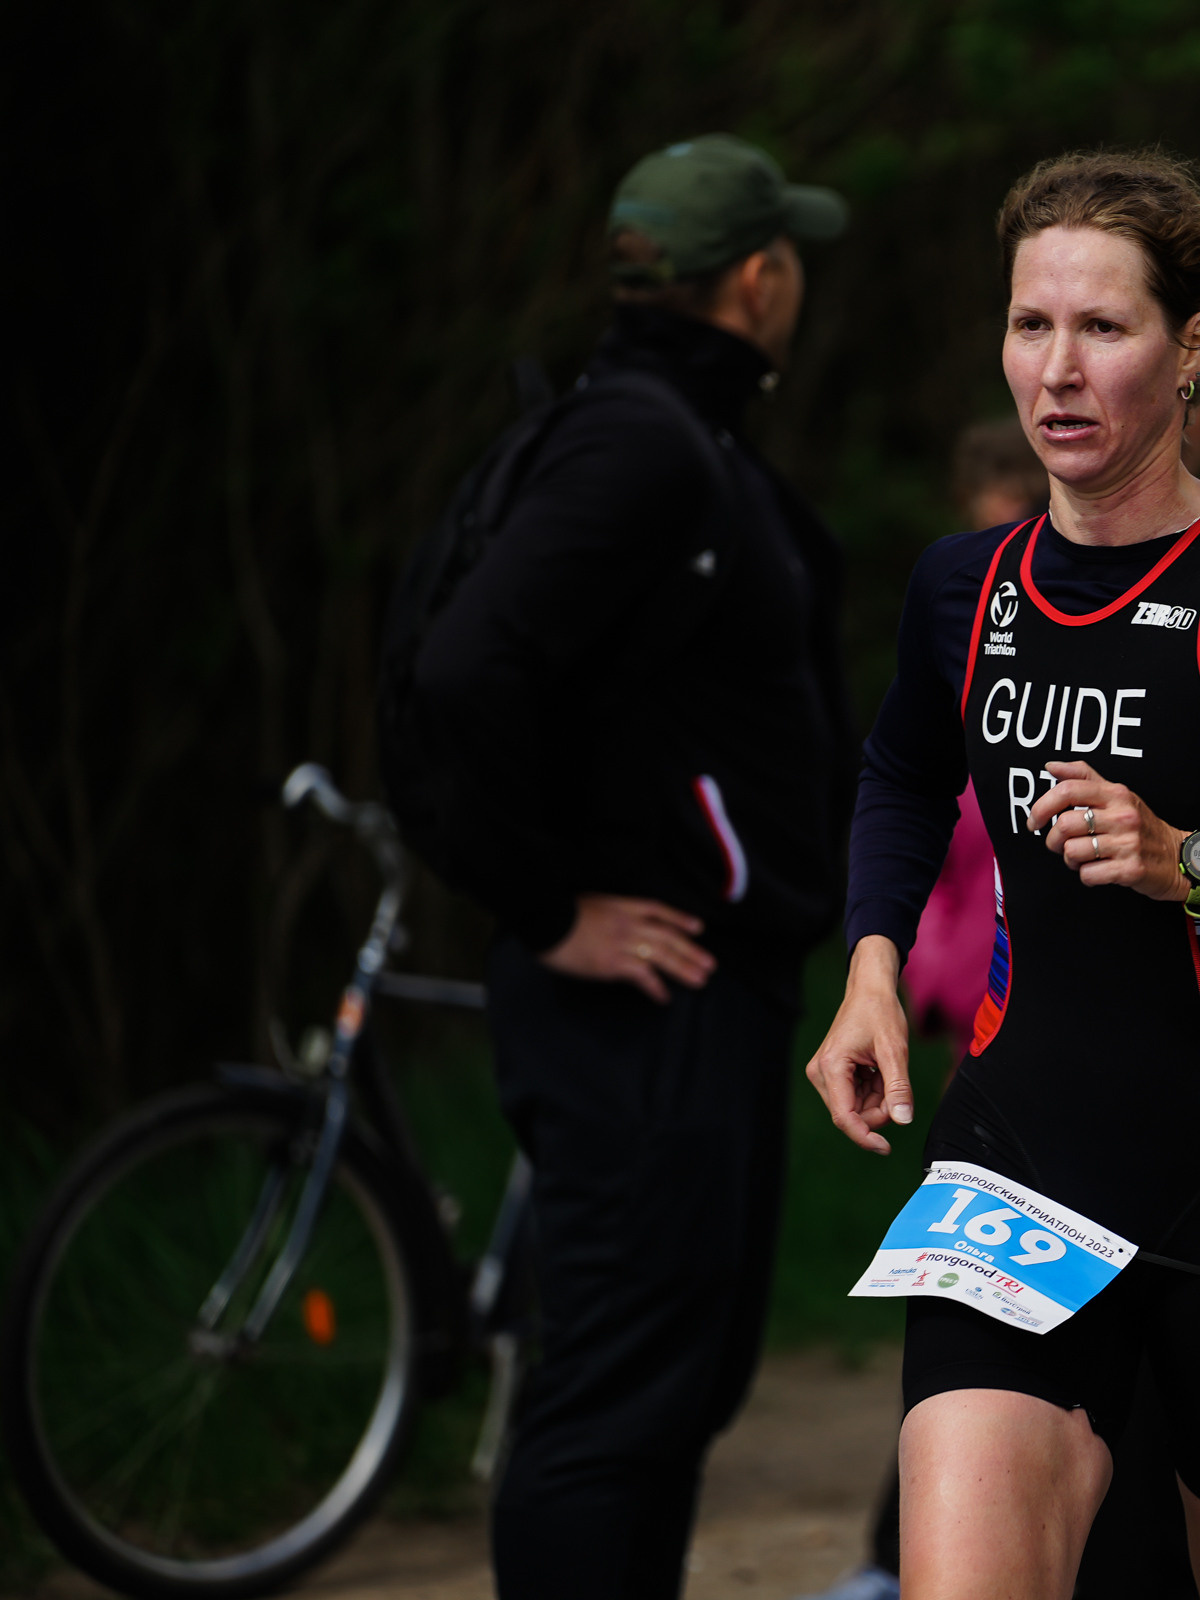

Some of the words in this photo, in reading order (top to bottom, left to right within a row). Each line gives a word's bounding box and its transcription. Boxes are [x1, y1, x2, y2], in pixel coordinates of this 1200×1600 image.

[983, 643, 1017, 657] Triathlon
[989, 631, 1014, 644] World
[981, 677, 1147, 758] GUIDE
[926, 1187, 1067, 1266] 169
[937, 1172, 1026, 1208] НОВГОРОДСКИЙ
[1026, 1203, 1087, 1244] ТРИАТЛОН
[1085, 1238, 1115, 1259] 2023
[953, 1240, 995, 1264] Ольга
